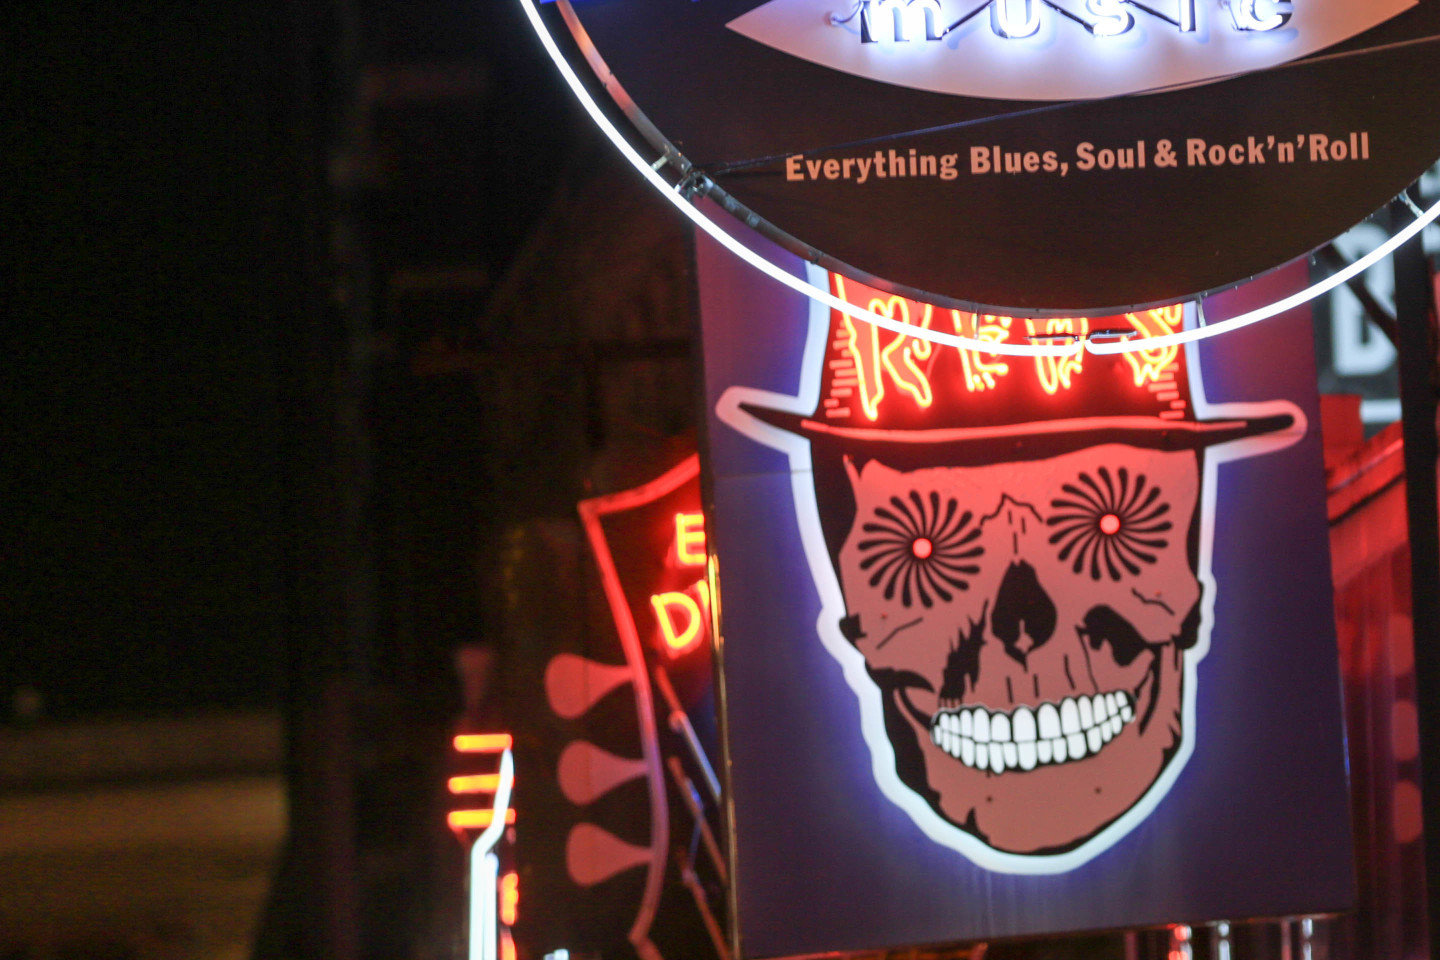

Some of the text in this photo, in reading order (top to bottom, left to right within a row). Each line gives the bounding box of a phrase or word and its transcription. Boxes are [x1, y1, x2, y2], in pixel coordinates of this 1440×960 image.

[786, 148, 958, 184] Everything
[970, 144, 1069, 177] Blues,
[1075, 140, 1146, 170] Soul
[1153, 139, 1178, 168] &
